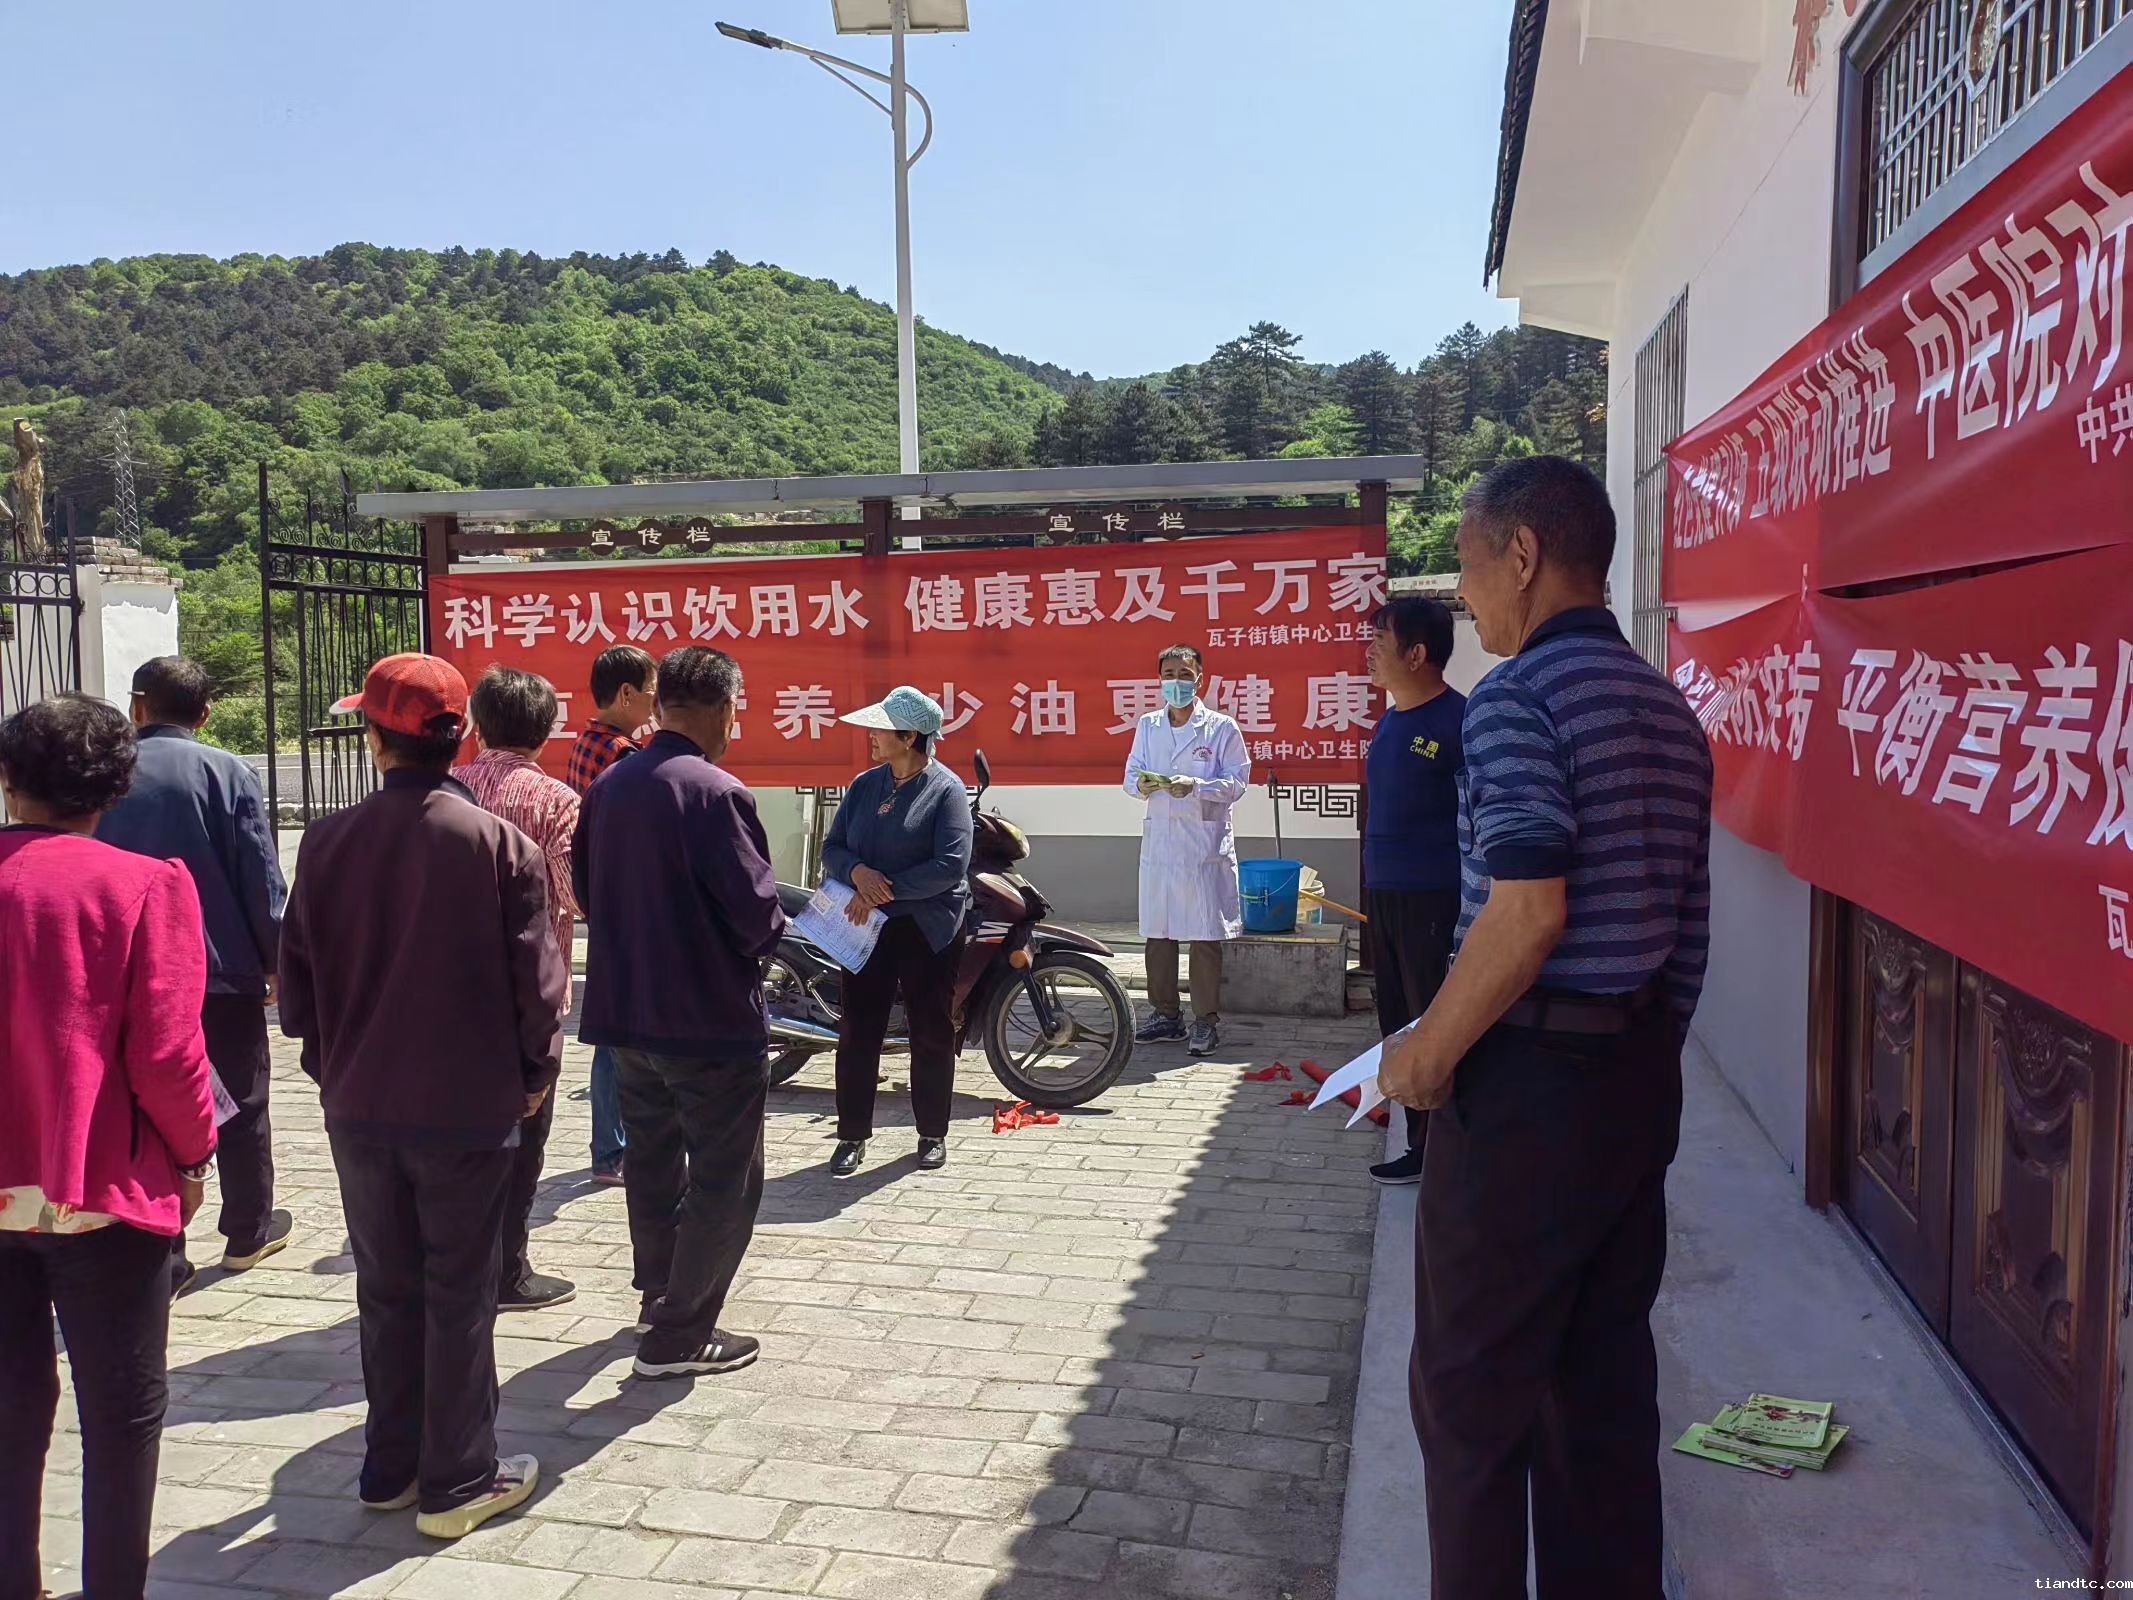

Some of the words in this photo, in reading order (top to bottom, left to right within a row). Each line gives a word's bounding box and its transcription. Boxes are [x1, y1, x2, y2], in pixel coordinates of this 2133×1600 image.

[1048, 512, 1186, 532] 宣传栏
[591, 526, 711, 546] 宣传栏
[444, 580, 870, 649] 科学认识饮用水
[904, 552, 1387, 632] 健康惠及千万家
[1206, 619, 1375, 648] 瓦子街镇中心卫生
[927, 671, 1378, 736] 少油更健康
[1409, 745, 1435, 760] CHINA
[1413, 736, 1440, 754] 中国
